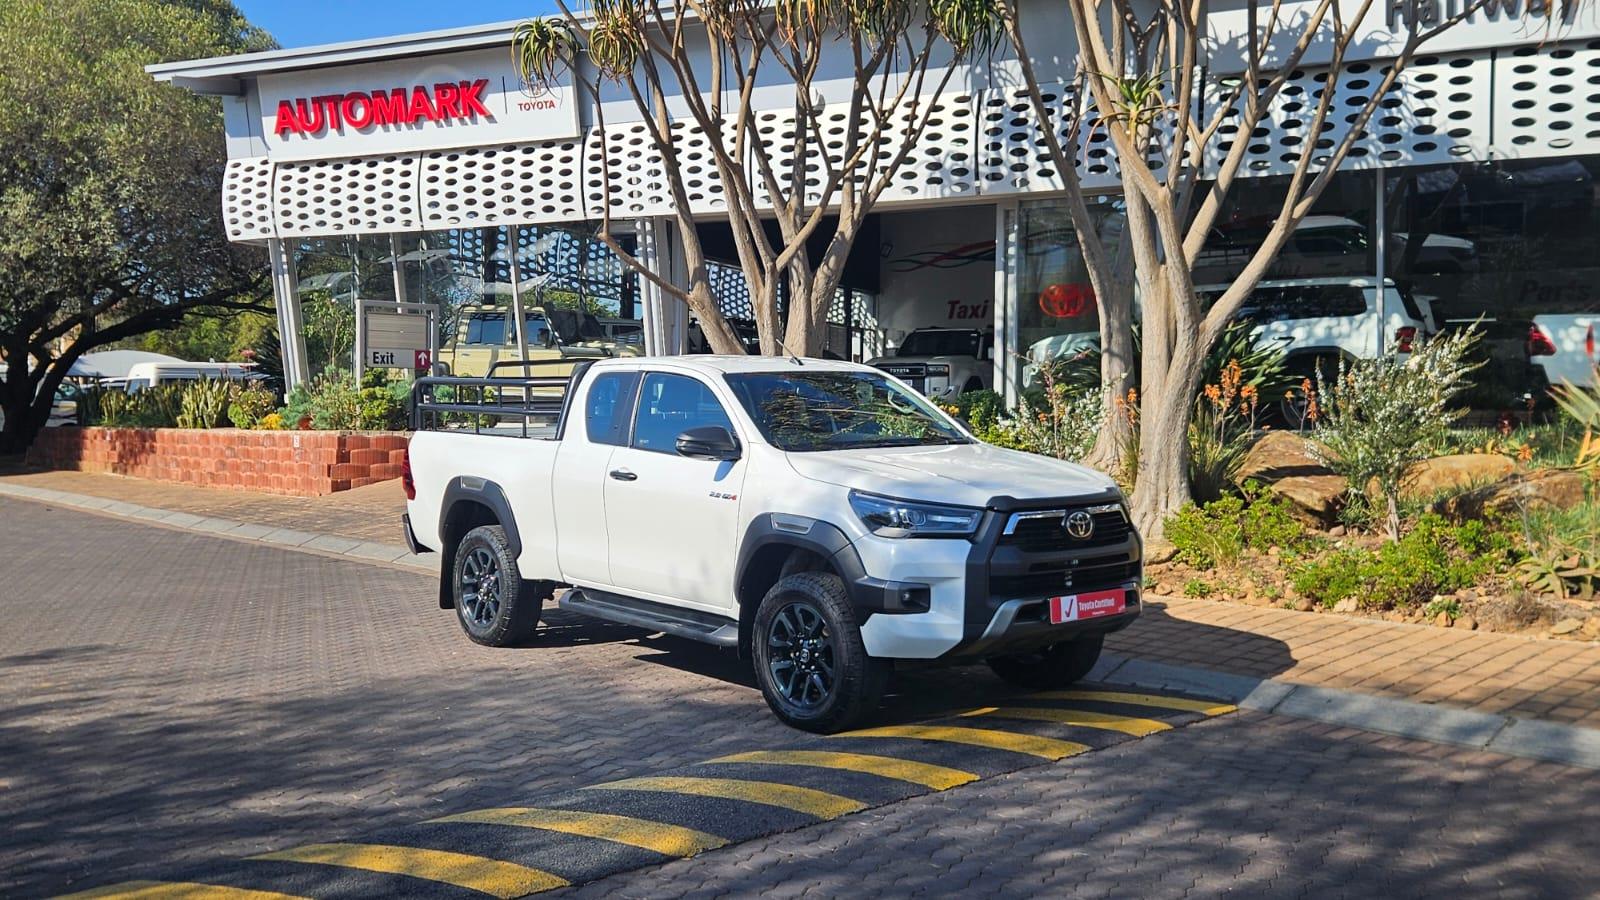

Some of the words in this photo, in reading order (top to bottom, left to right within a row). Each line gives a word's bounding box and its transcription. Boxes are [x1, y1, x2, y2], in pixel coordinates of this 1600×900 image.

[274, 78, 491, 135] AUTOMARK
[517, 100, 556, 112] TOYOTA
[947, 299, 990, 319] Taxi
[372, 351, 395, 365] Exit
[1078, 601, 1094, 612] Toyota
